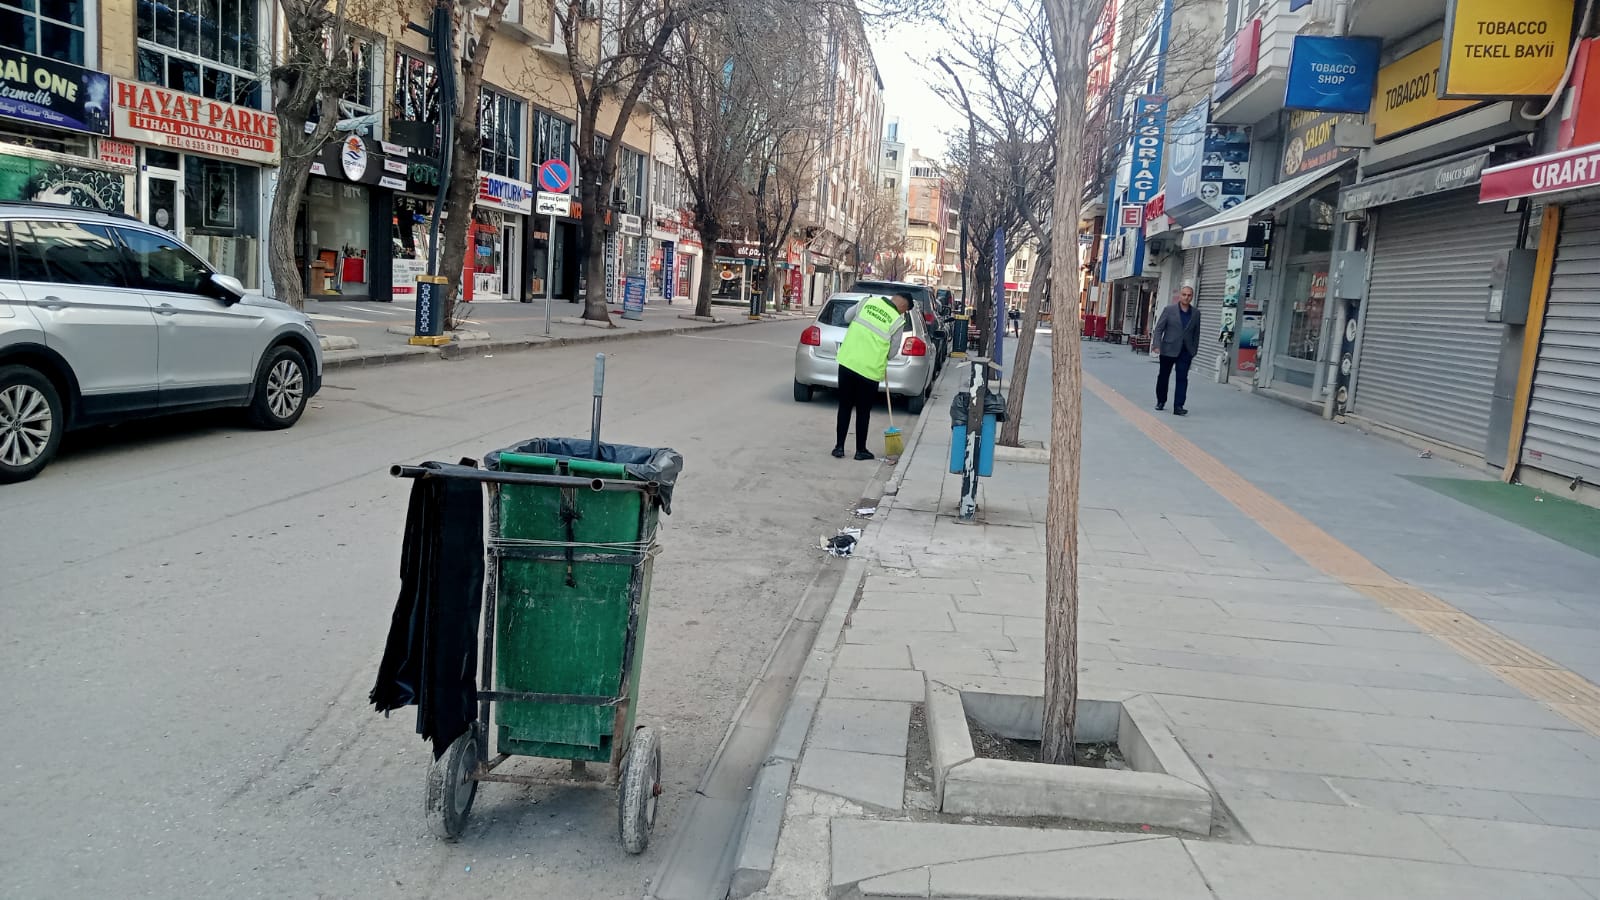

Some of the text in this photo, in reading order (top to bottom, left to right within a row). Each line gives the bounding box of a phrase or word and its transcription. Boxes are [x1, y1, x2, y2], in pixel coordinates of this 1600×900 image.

[1476, 20, 1547, 36] TOBACCO
[1464, 44, 1510, 58] TEKEL
[1310, 62, 1356, 75] TOBACCO
[34, 67, 79, 103] ONE
[1317, 74, 1346, 85] SHOP
[1385, 71, 1430, 113] TOBACCO
[117, 81, 279, 139] HAYAT PARKE
[135, 113, 265, 151] İTHAL DUVAR KAĞIDI
[185, 139, 190, 149] 0
